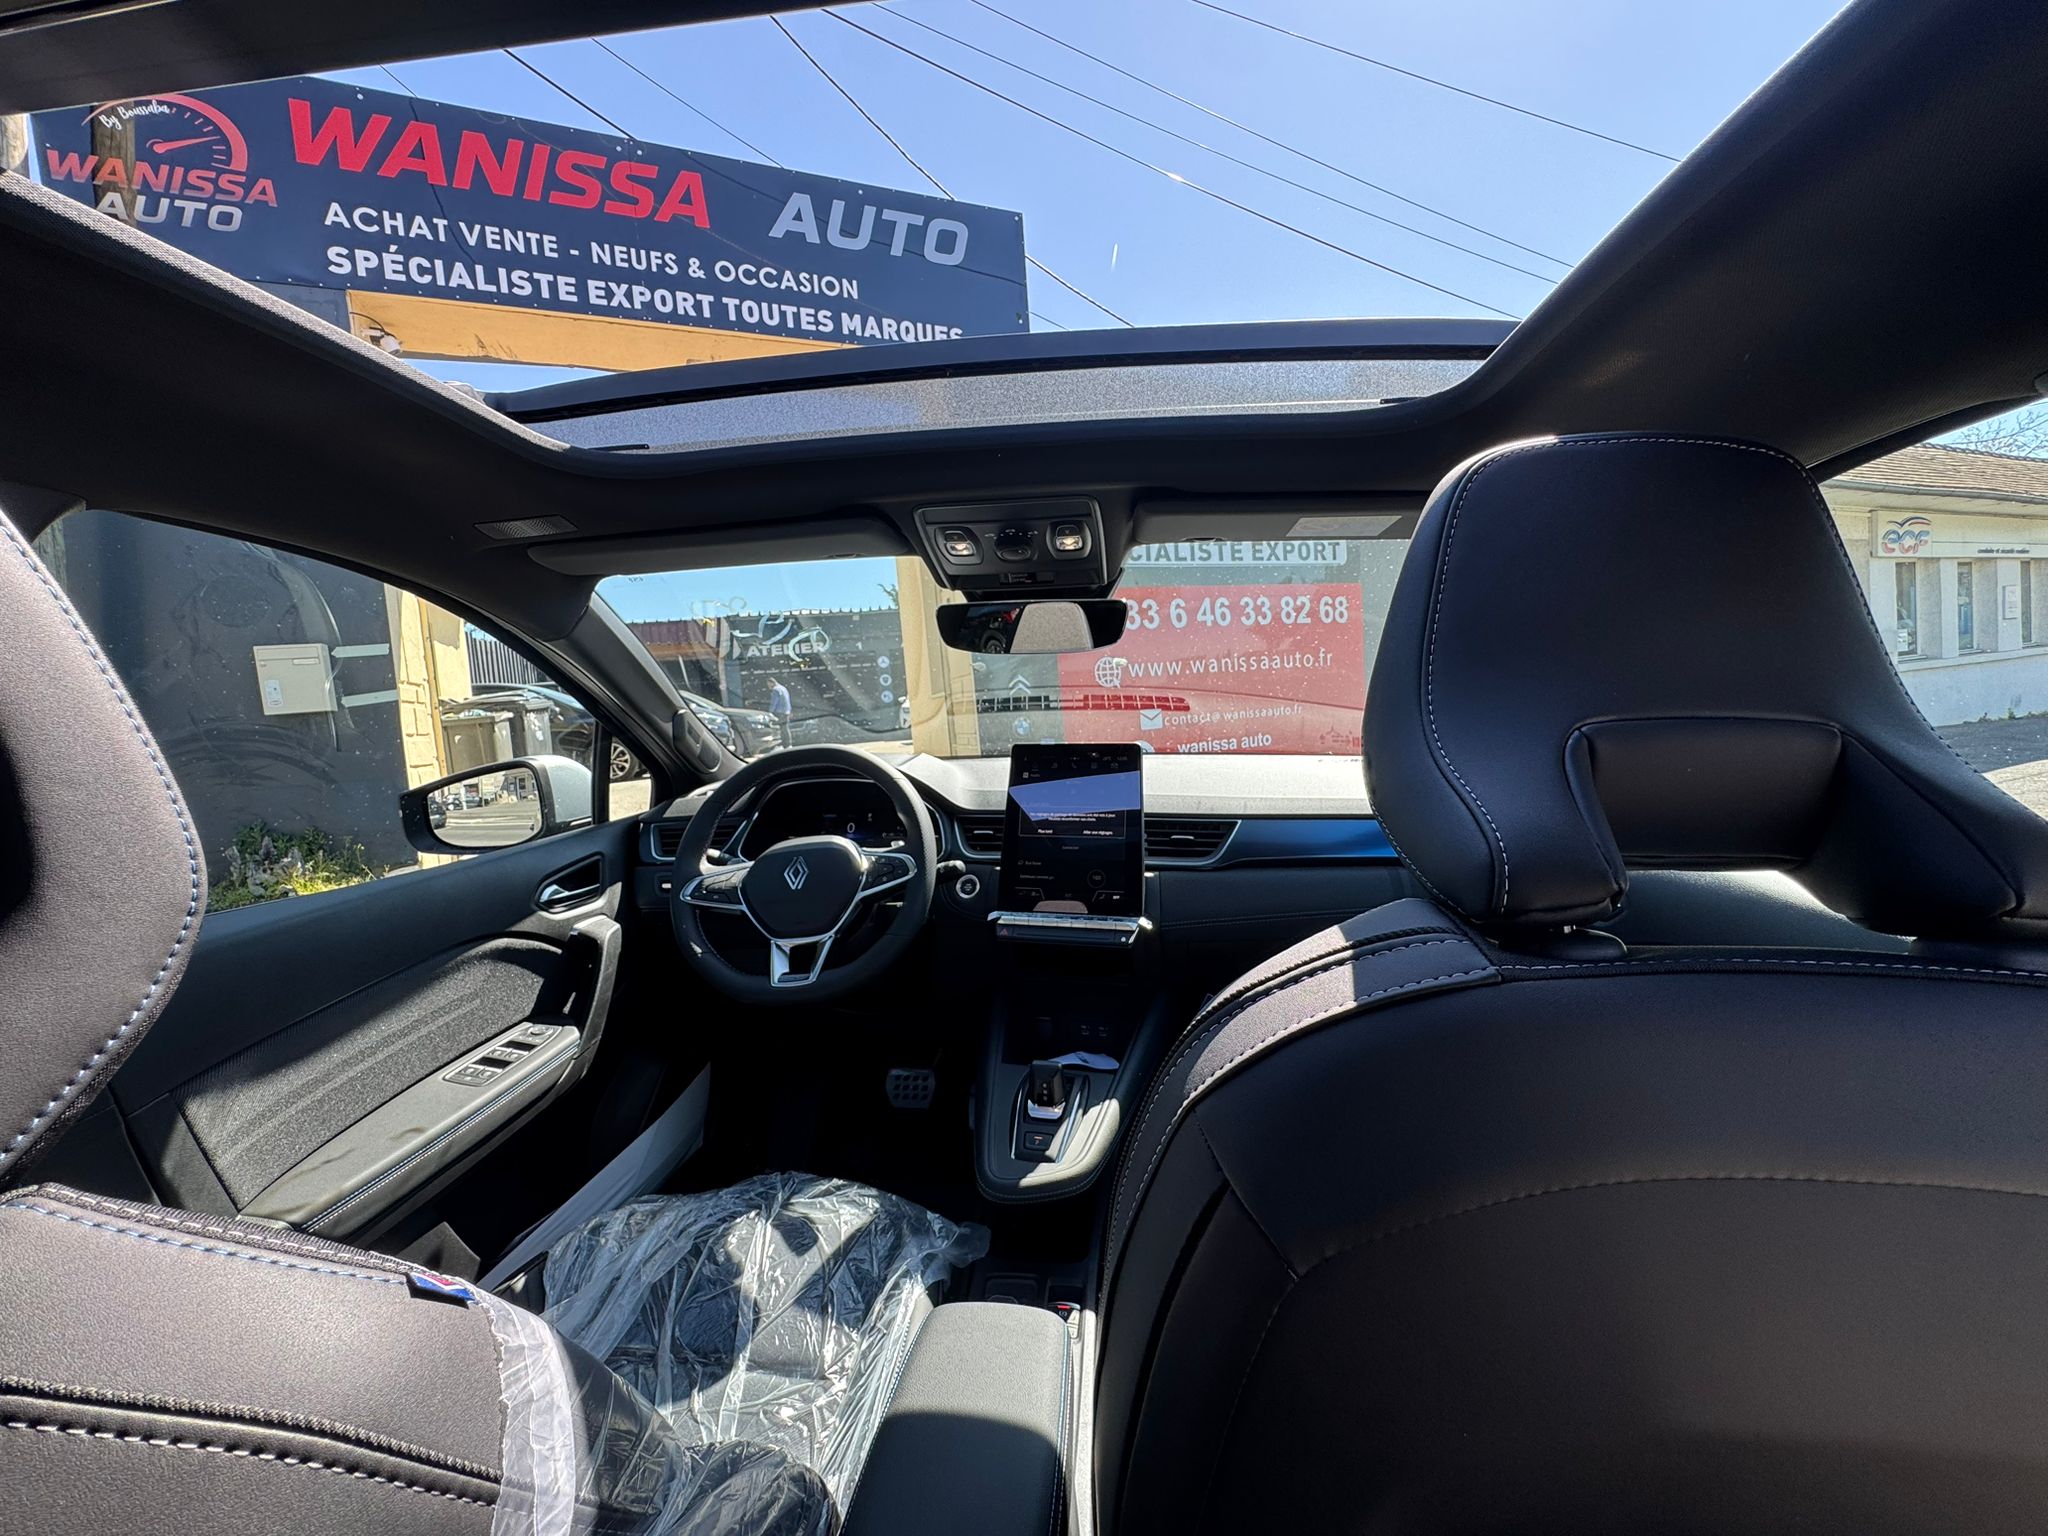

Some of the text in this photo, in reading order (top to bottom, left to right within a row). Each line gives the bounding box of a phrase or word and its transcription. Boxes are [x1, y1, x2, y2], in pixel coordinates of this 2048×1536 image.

[98, 114, 122, 130] By
[47, 148, 278, 207] WANISSA
[288, 97, 711, 229] WANISSA
[96, 191, 243, 232] AUTO
[769, 192, 969, 266] AUTO
[324, 202, 449, 242] ACHAT
[458, 221, 559, 258] VENTE
[591, 242, 679, 276] NEUFS
[688, 257, 706, 280] &
[714, 260, 859, 300] OCCASION
[326, 244, 579, 303] SPÉCIALISTE
[587, 280, 715, 319] EXPORT
[722, 297, 835, 333] TOUTES
[1252, 541, 1341, 562] EXPORT
[1169, 598, 1188, 629] 6
[1196, 597, 1232, 627] 46
[1239, 596, 1273, 626] 33
[1280, 596, 1312, 625] 82
[1319, 595, 1349, 625] 68
[747, 641, 826, 657] ATELIER
[1128, 649, 1334, 678] www.wanissaauto.fr
[1177, 732, 1273, 754] wanissa auto
